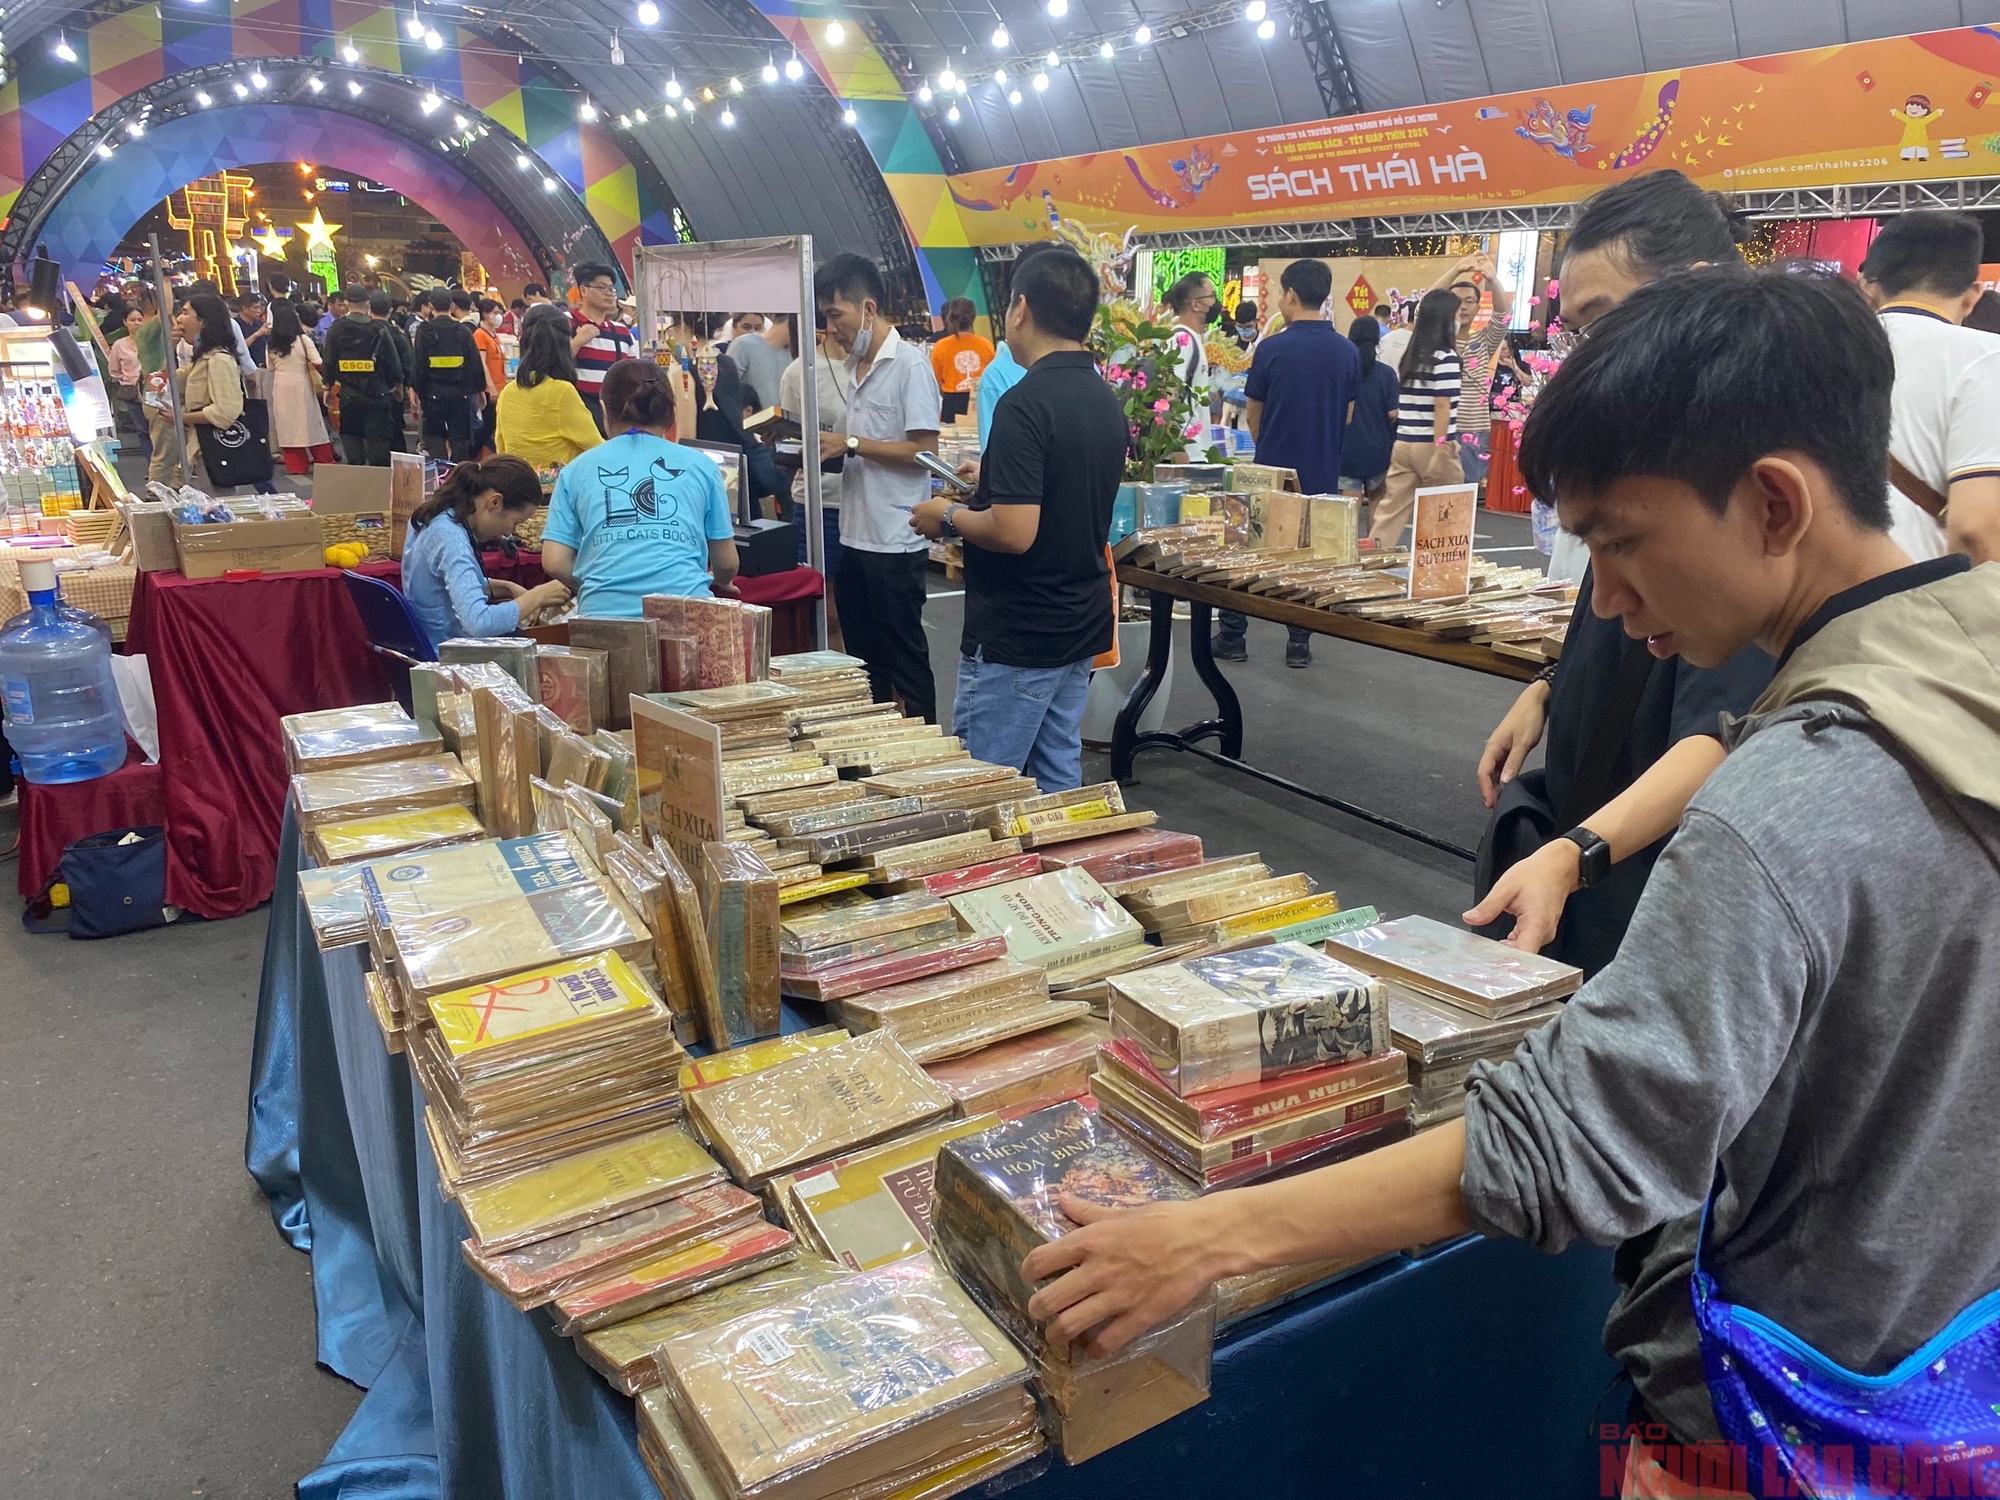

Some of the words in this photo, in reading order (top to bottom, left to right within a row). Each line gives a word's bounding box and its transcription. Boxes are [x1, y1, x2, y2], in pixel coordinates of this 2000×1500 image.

[1379, 115, 1392, 128] PHỐ
[1405, 113, 1417, 124] CHÍ
[1284, 143, 1296, 154] HỘI
[1323, 135, 1343, 149] SÁCH
[1349, 132, 1364, 145] TẾT
[1366, 130, 1383, 143] GIÁP
[1385, 128, 1406, 141] THÌN
[1408, 127, 1429, 139] 2024
[1247, 165, 1334, 201] SÁCH
[1339, 152, 1422, 192] THÁI
[1429, 145, 1487, 184] HÀ
[1734, 157, 1888, 176] facebook.com/thaiha2206
[1236, 474, 1273, 488] INDOCHINE
[592, 530, 624, 547] LITTLE
[626, 529, 659, 541] CATS
[662, 529, 697, 546] BOOKS
[1416, 536, 1445, 550] SÁCH
[1447, 534, 1469, 548] XƯA
[1441, 547, 1467, 562] HIẾM
[1014, 890, 1062, 942] TRUNG-HOA
[1275, 909, 1291, 920] HỌC
[1291, 905, 1309, 915] KANT
[895, 1174, 921, 1200] TỪ
[913, 1202, 931, 1226] ĐI
